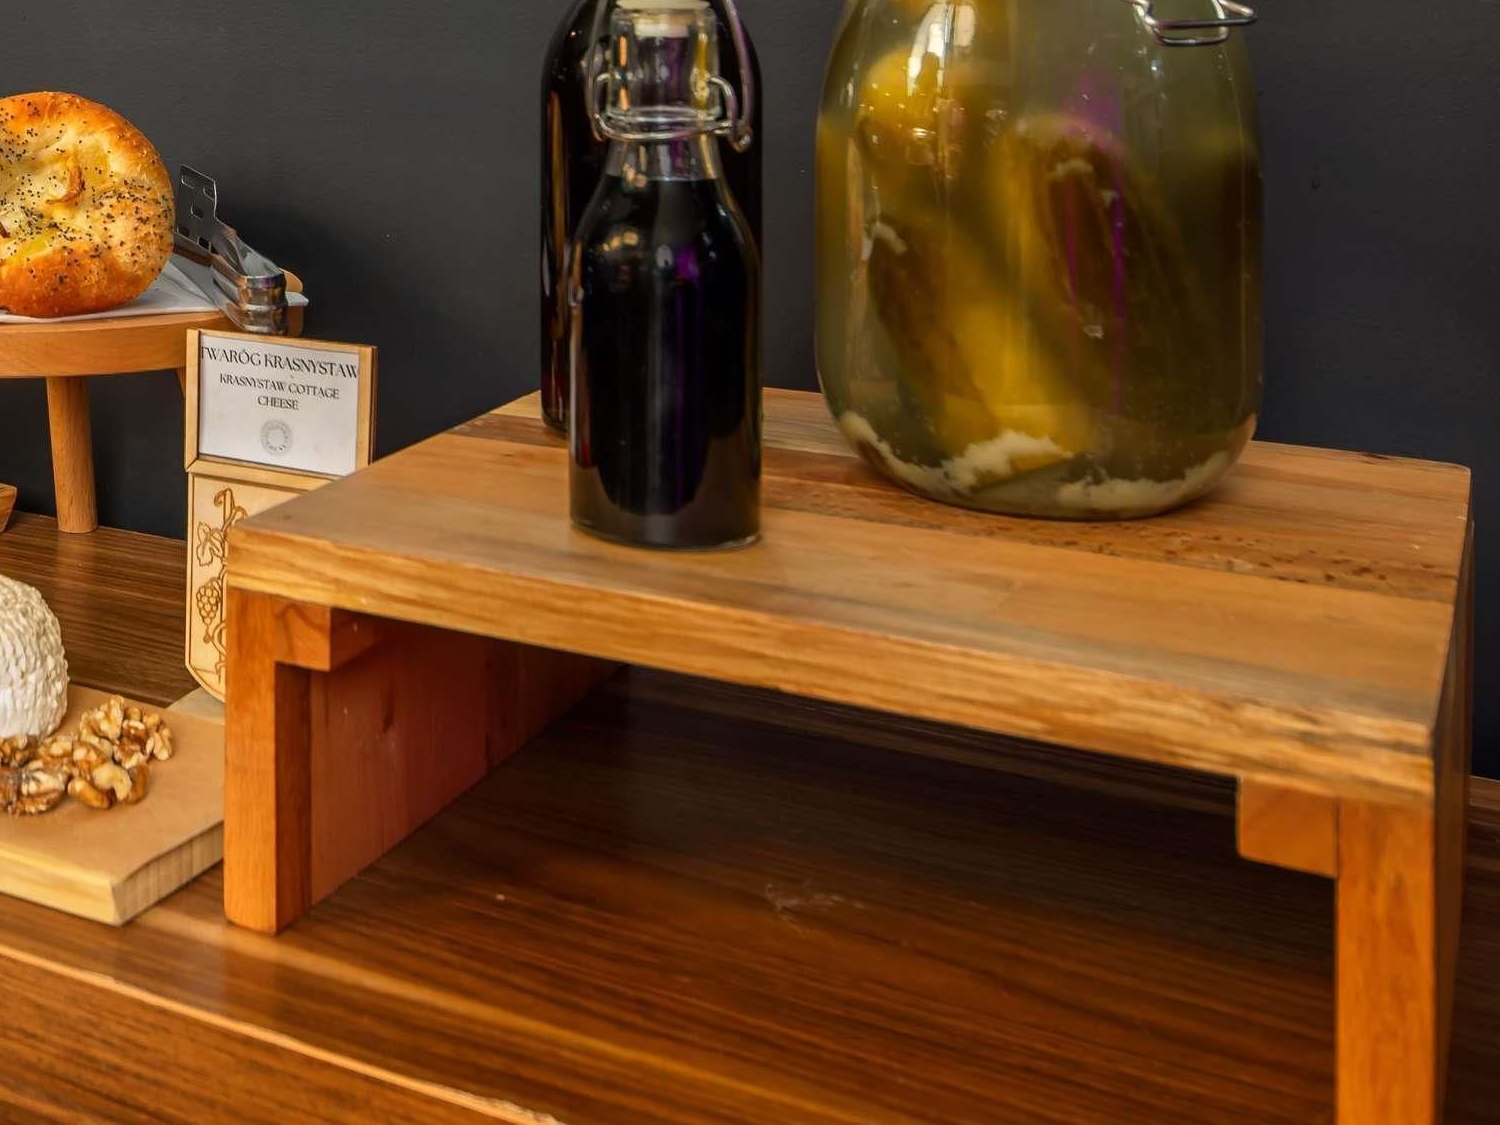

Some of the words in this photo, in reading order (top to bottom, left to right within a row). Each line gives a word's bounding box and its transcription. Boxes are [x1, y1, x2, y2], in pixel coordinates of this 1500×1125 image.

[264, 354, 358, 379] KRASNYSTAW
[219, 373, 286, 392] KRASNYSTAW
[287, 382, 340, 400] COTTAGE
[256, 395, 300, 411] CHEESE
